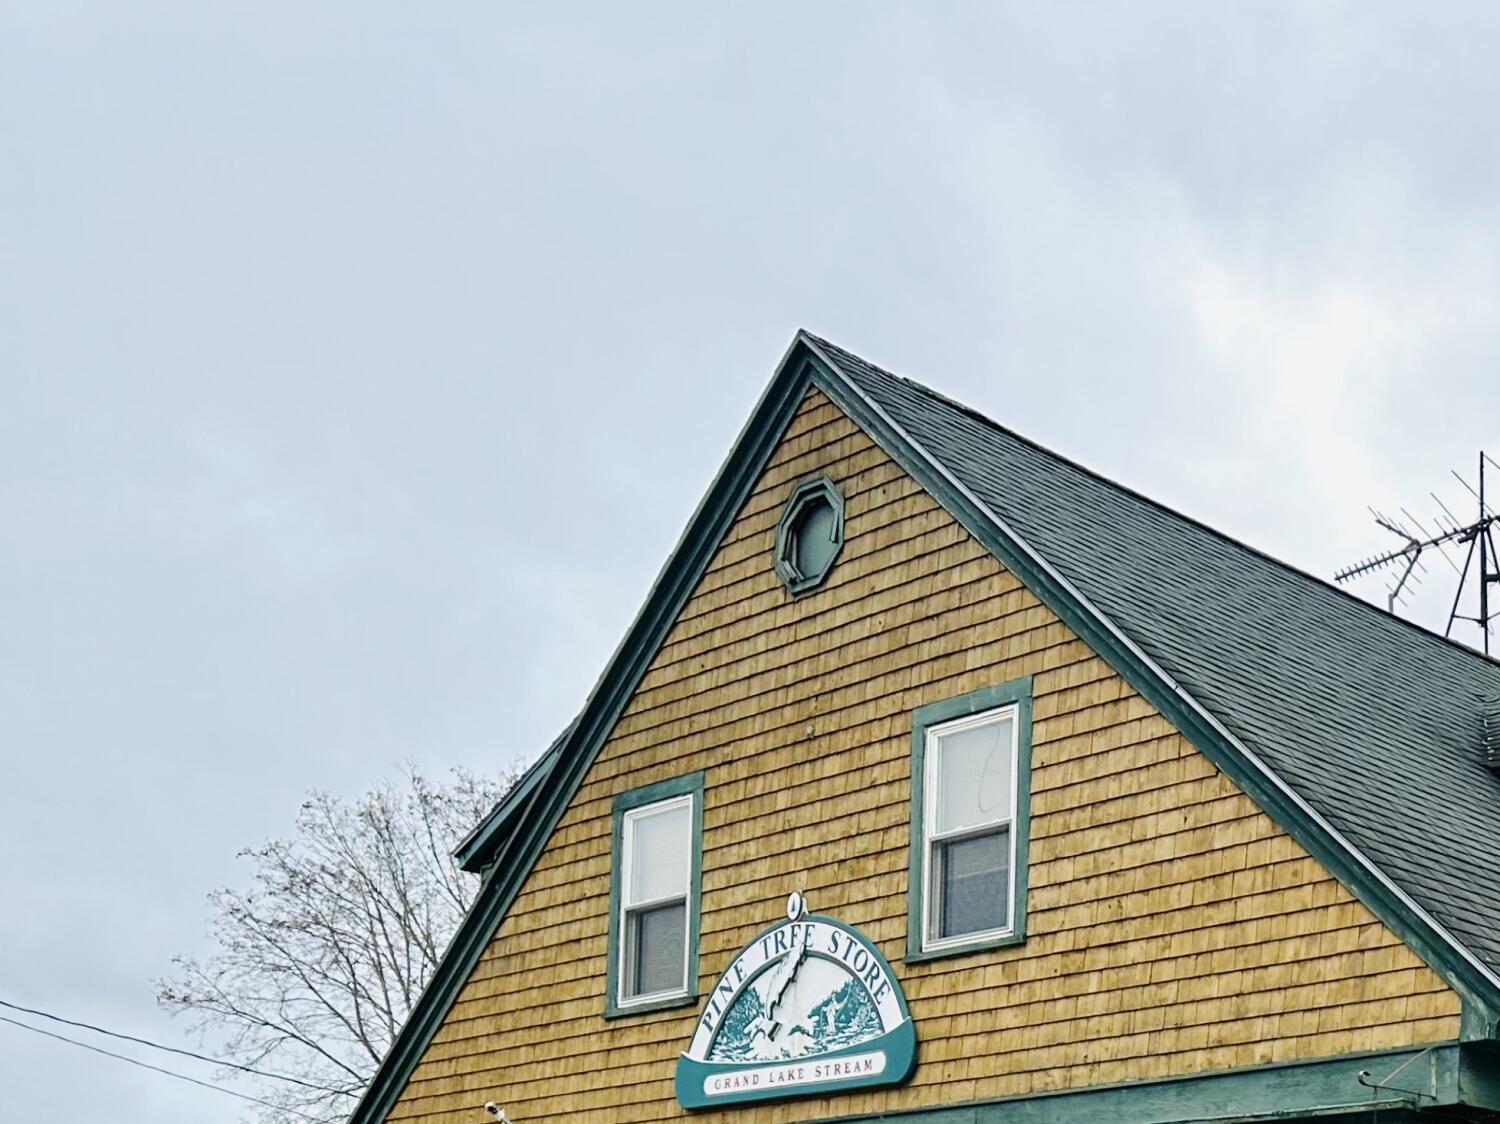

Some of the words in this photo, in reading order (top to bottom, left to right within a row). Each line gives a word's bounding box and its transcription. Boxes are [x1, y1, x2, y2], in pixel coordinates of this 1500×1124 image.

[701, 958, 747, 1033] PINE
[760, 924, 816, 959] TREE
[828, 930, 891, 1006] STORE
[714, 1073, 760, 1091] GRAND
[769, 1067, 804, 1083] LAKE
[815, 1059, 873, 1078] STREAM
